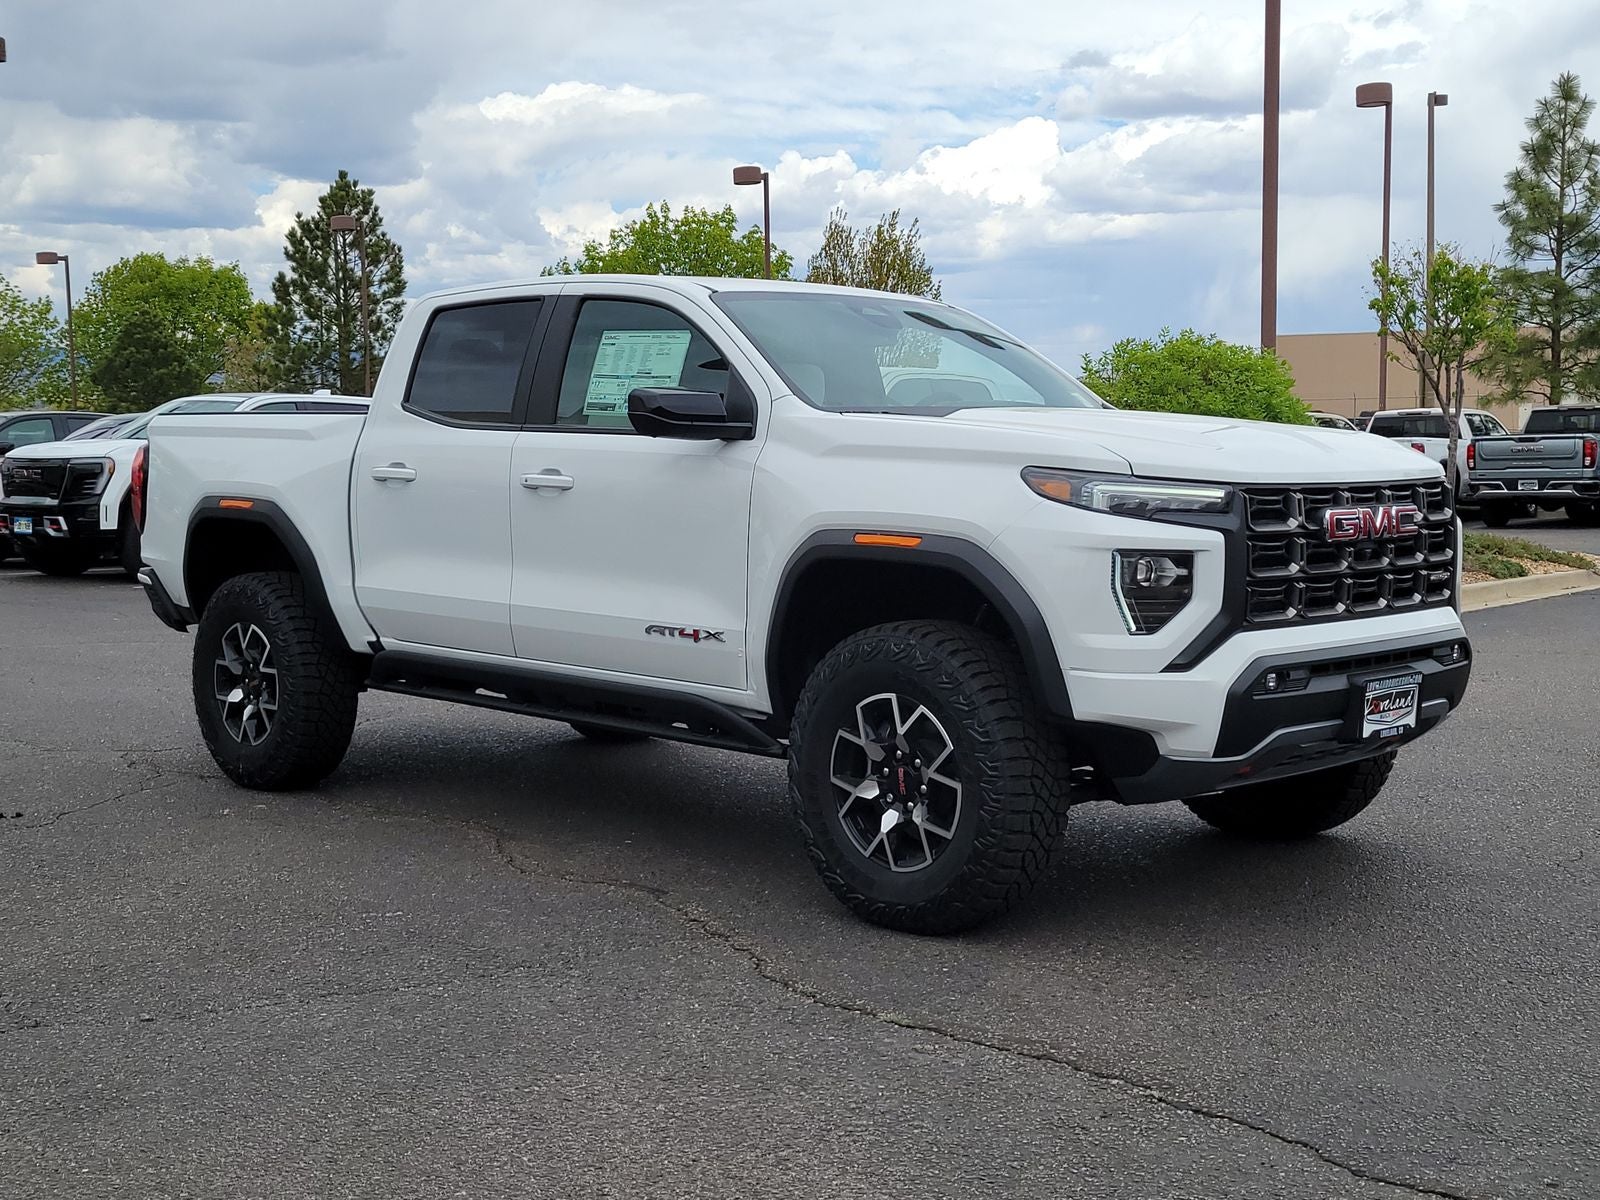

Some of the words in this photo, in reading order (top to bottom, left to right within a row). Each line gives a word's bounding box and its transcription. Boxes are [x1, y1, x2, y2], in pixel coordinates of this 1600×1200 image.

[1511, 444, 1544, 454] GMC
[12, 468, 42, 478] GMC
[1325, 504, 1420, 541] GMC
[644, 624, 726, 643] AT4X
[1364, 690, 1414, 715] Loveland
[898, 767, 906, 795] GMC
